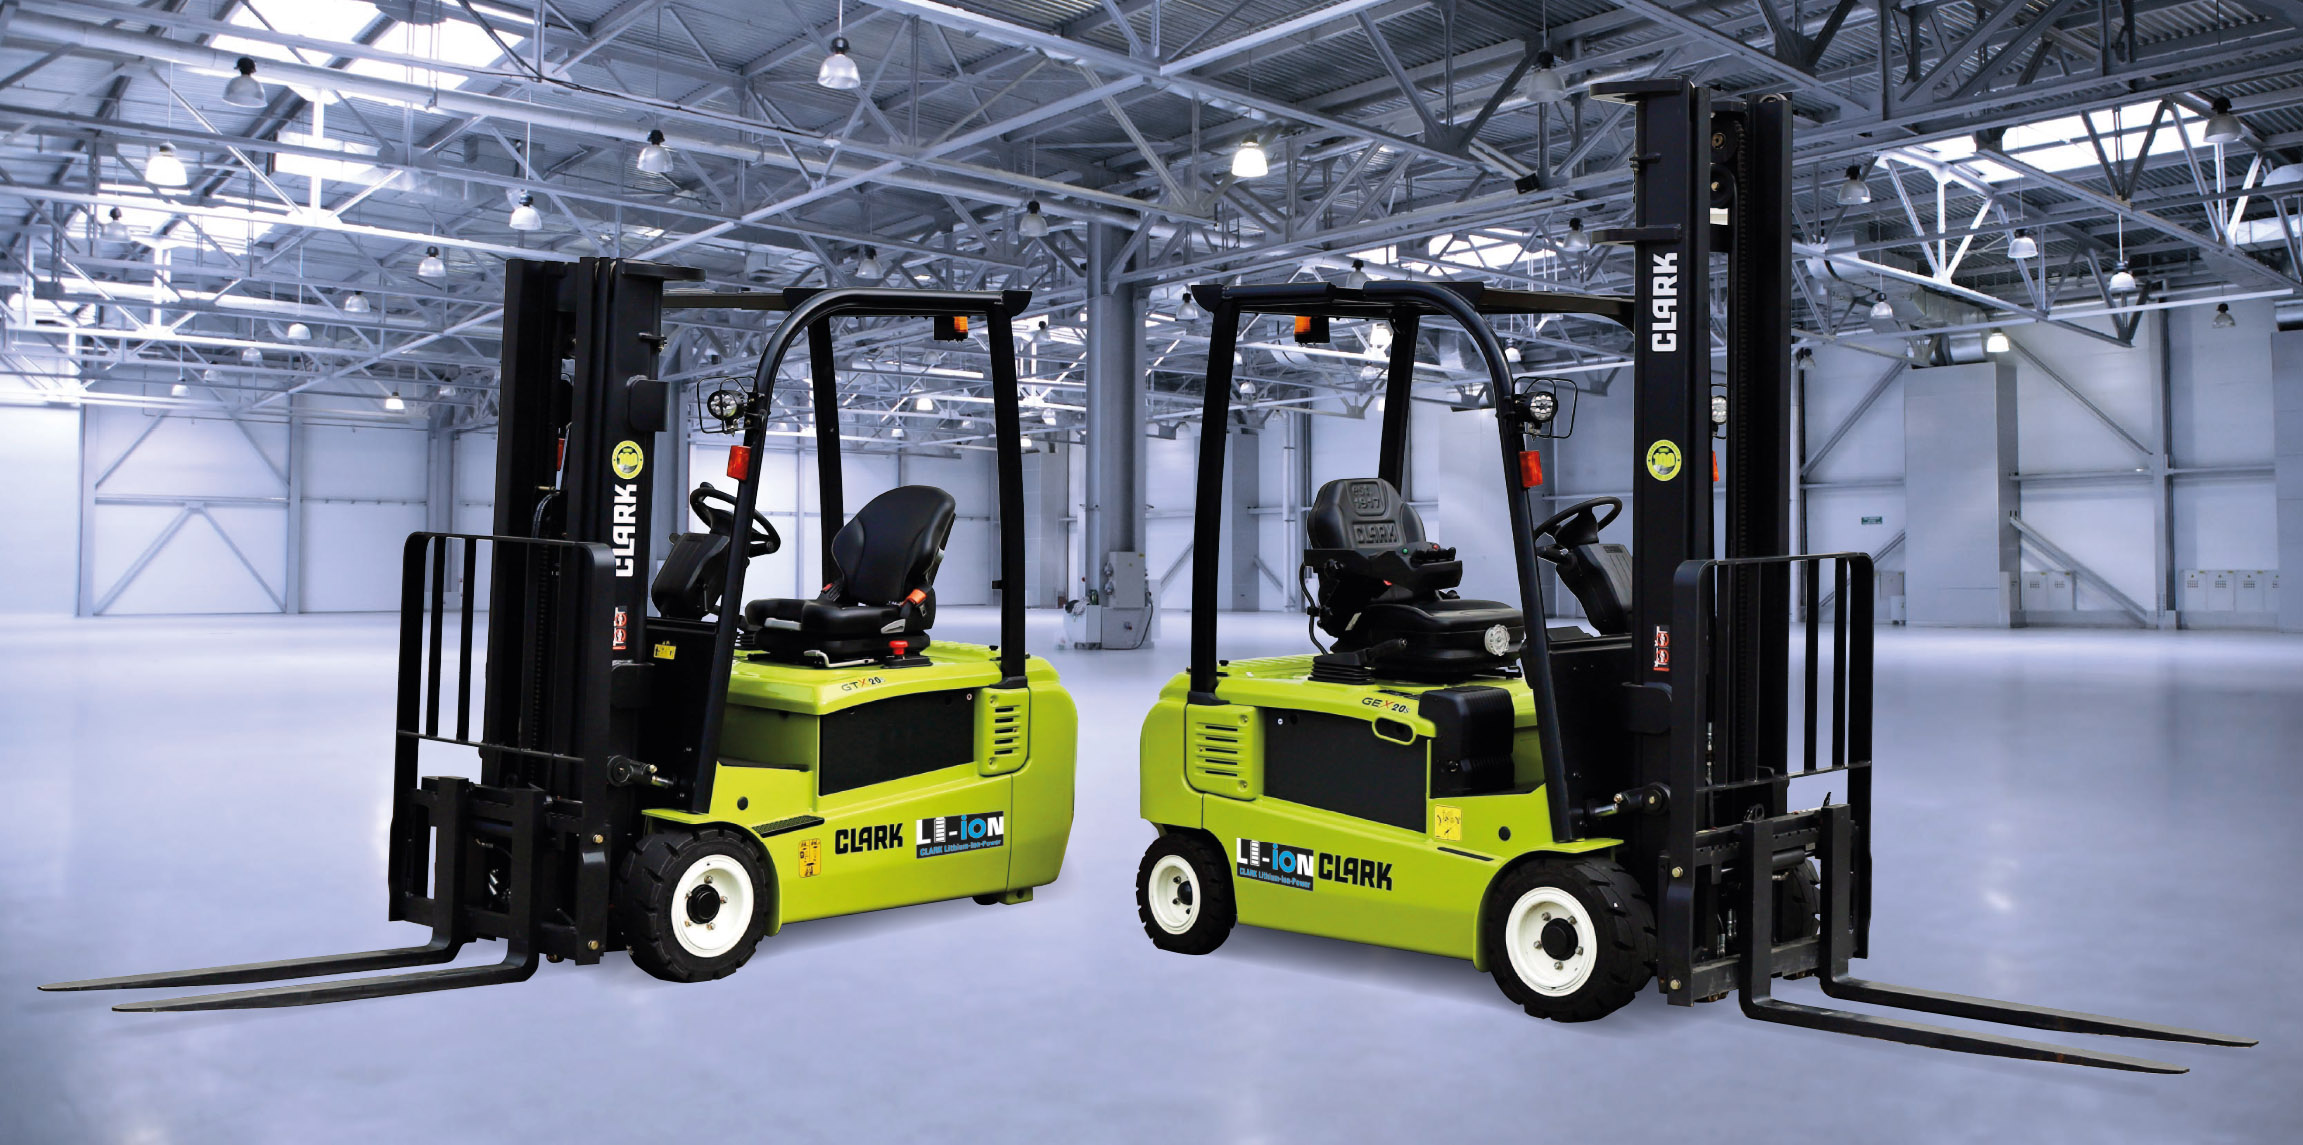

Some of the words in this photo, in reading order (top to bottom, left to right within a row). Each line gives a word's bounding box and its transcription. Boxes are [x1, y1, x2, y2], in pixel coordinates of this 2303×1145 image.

[1652, 252, 1678, 352] CLARK
[613, 484, 637, 577] CLARK
[1353, 524, 1398, 544] CLARK
[841, 678, 866, 691] GTX
[1361, 697, 1394, 709] GEX
[835, 823, 903, 855] CLARK
[920, 845, 943, 857] CLARK
[1239, 867, 1258, 879] CLARK
[1318, 852, 1393, 892] CLARK
